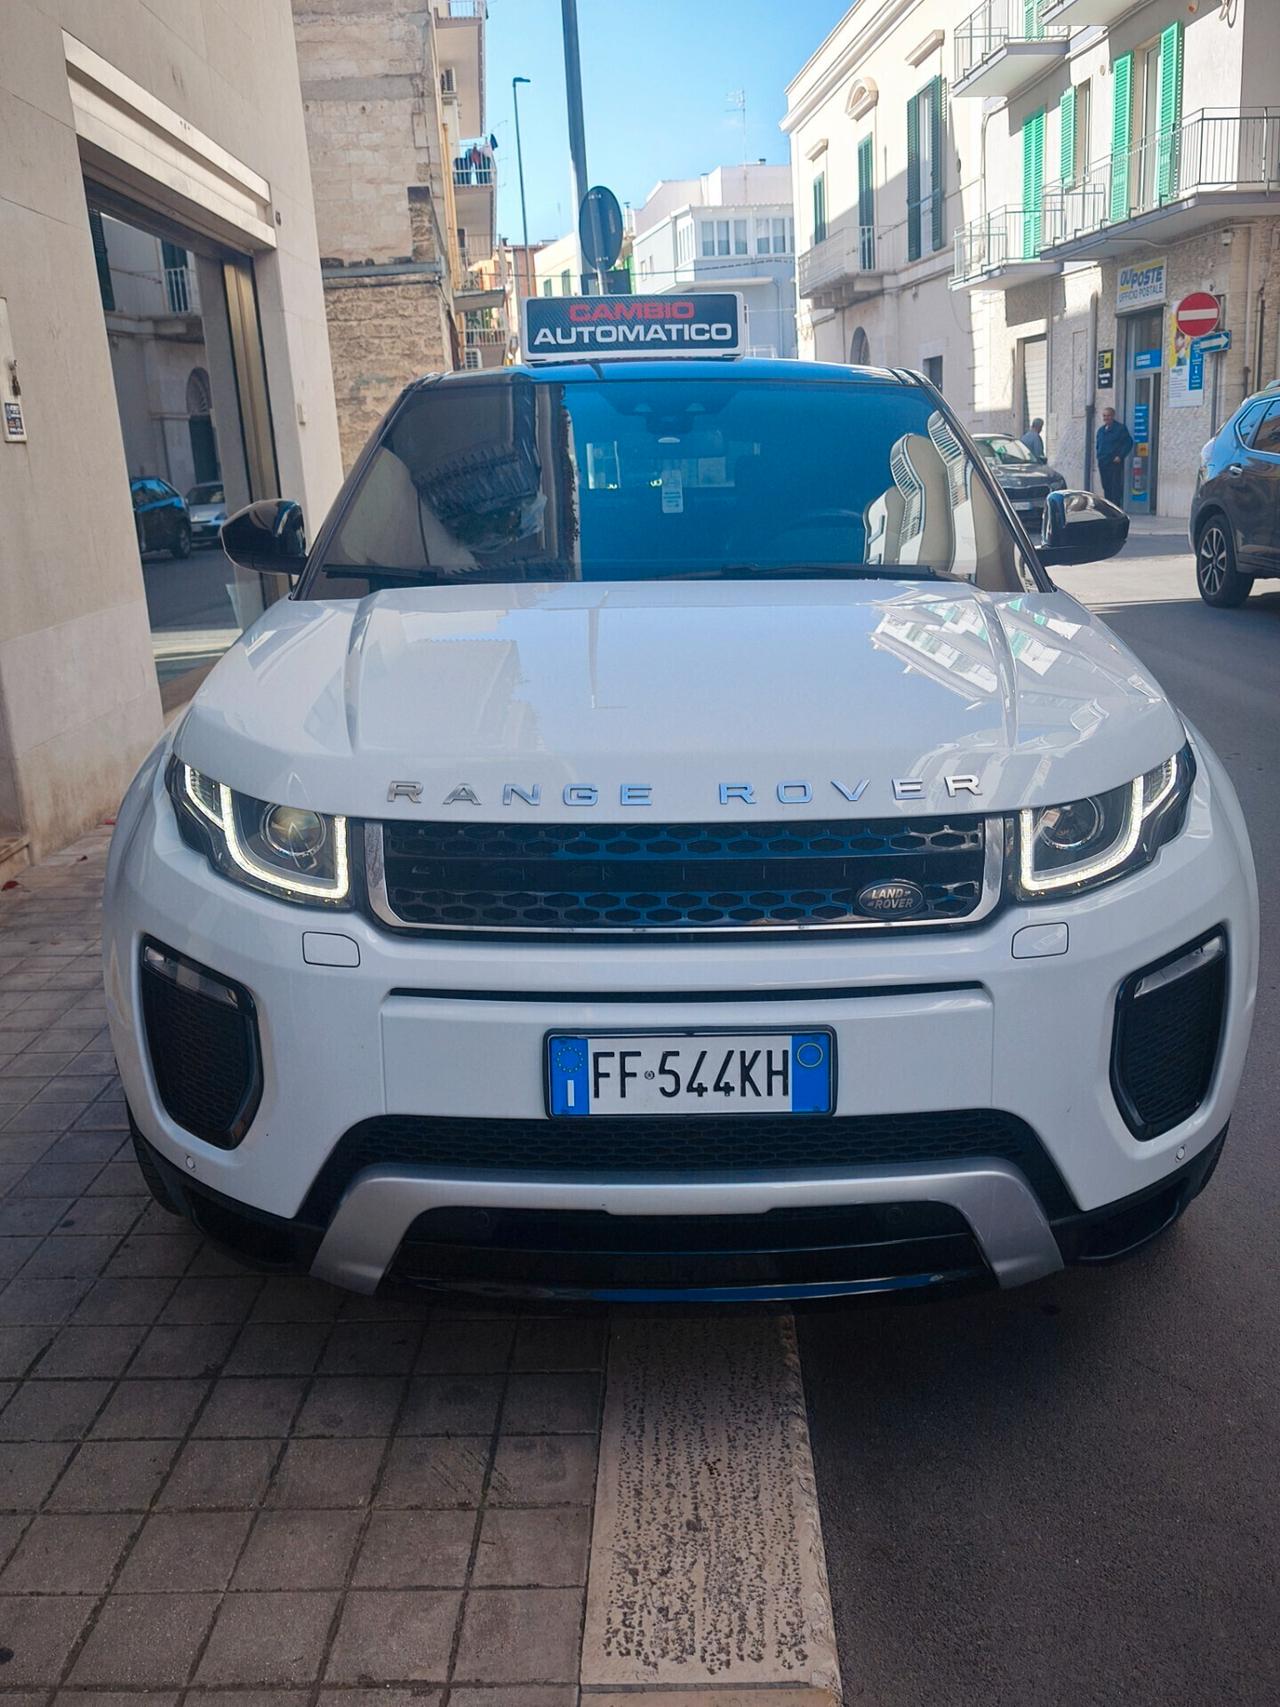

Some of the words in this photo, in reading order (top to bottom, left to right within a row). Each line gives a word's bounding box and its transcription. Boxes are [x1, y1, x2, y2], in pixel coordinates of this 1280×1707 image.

[569, 302, 695, 322] CAMBIO
[533, 323, 732, 345] AUTOMATICO
[387, 780, 653, 807] RANGE
[719, 775, 983, 805] ROVER
[871, 888, 904, 899] LAND
[874, 898, 914, 909] ROVER
